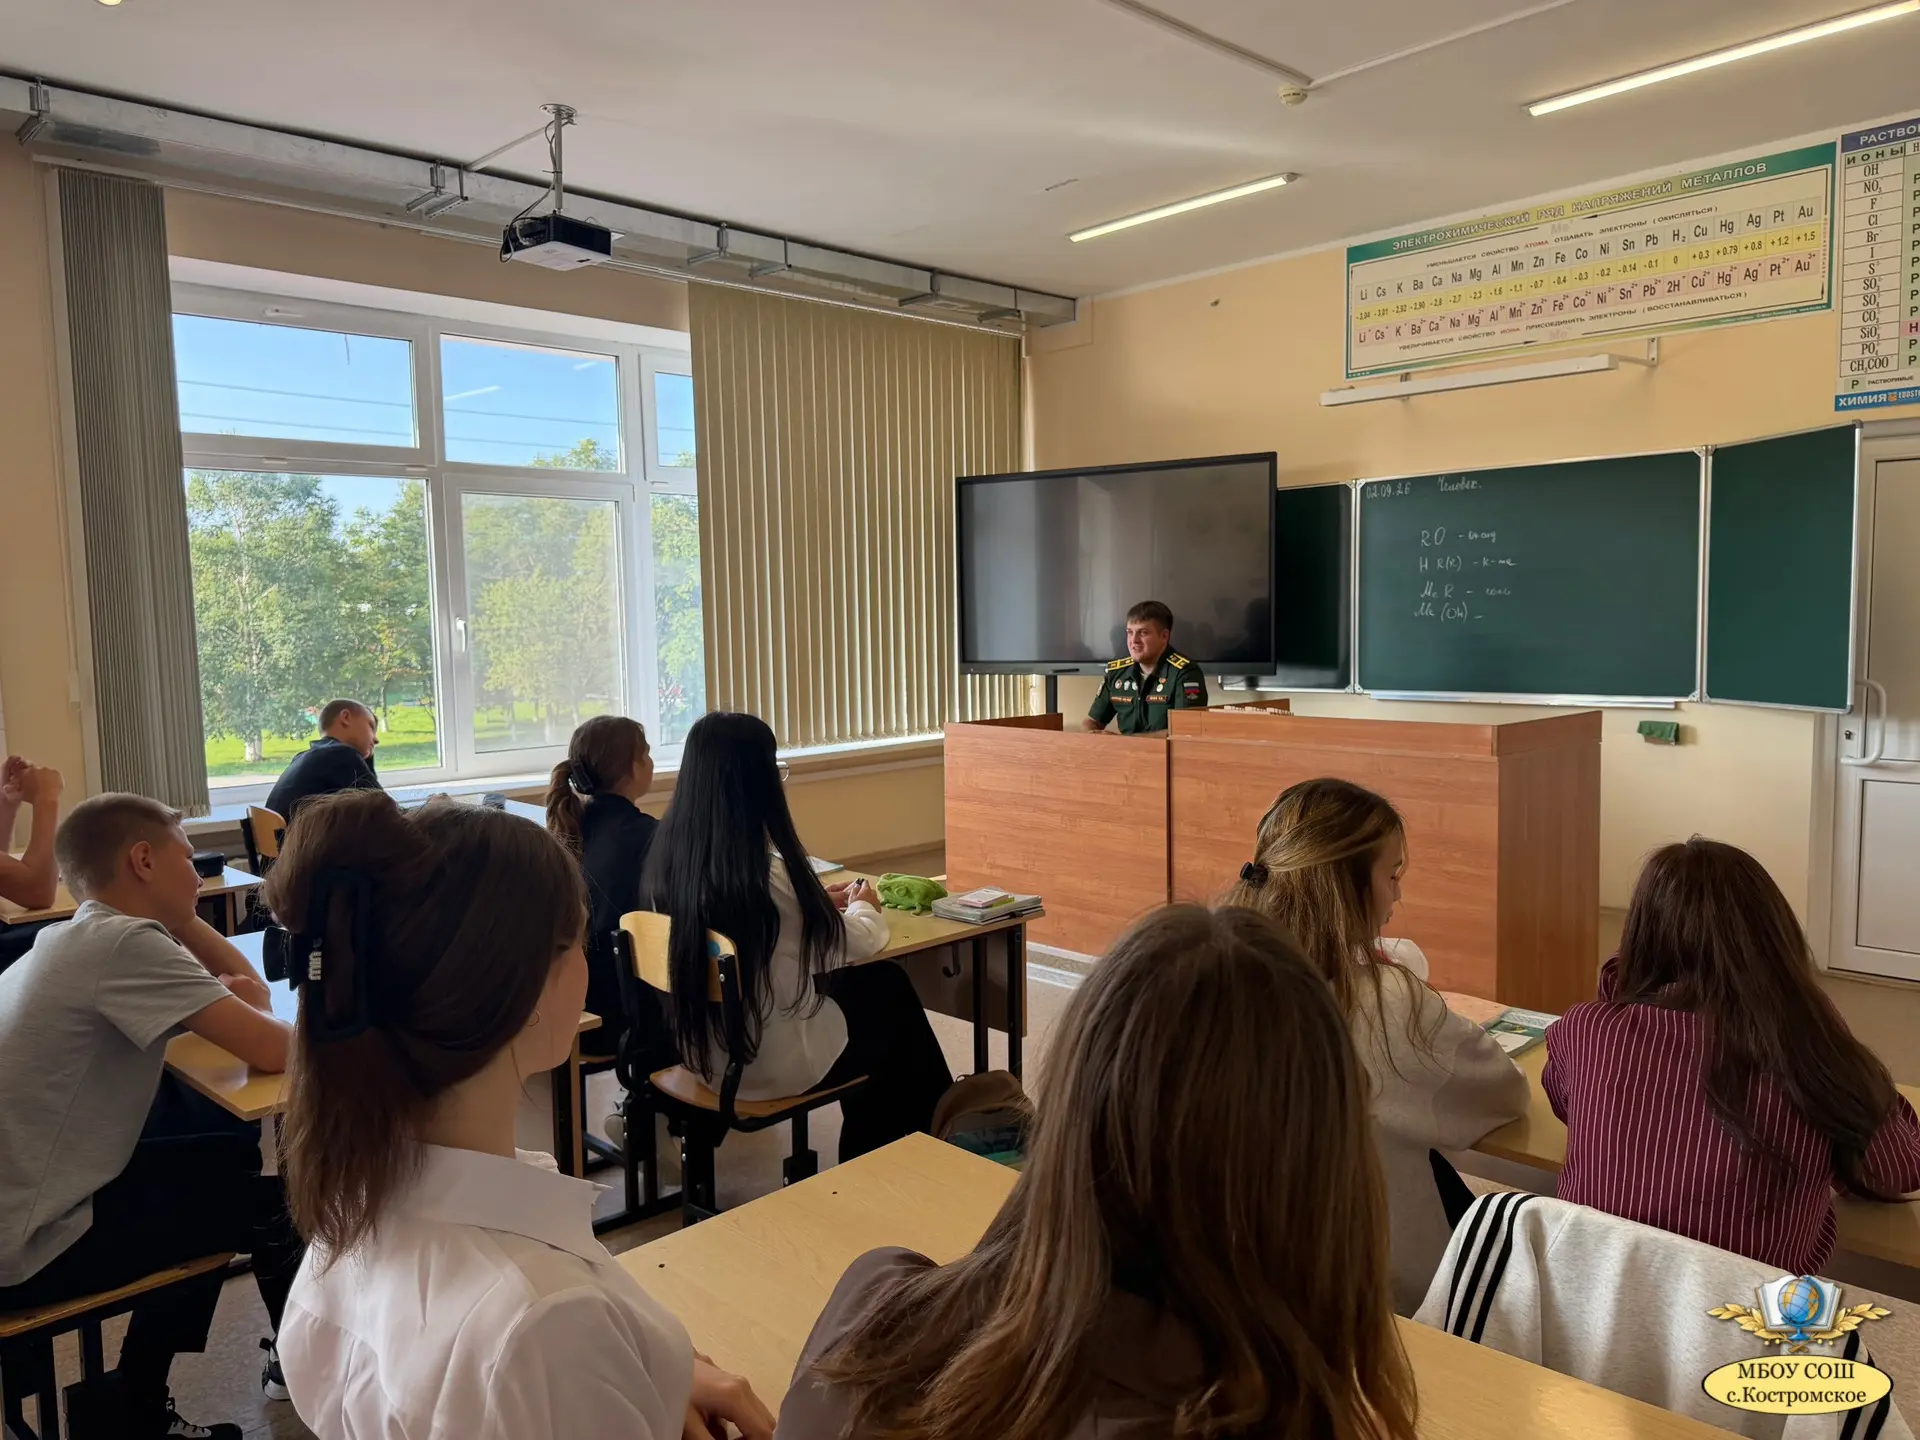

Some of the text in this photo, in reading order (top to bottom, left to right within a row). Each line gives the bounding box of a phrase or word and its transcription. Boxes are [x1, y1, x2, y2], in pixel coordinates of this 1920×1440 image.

[1860, 124, 1920, 145] РАСТВО
[1392, 162, 1767, 250] ЭЛЕКТРОХИМИЧЕСКИЙ РЯД НАПРЯЖЕНИЙ МЕТАЛЛОВ
[1360, 290, 1367, 300] Li
[1376, 286, 1386, 298] Cs
[1397, 282, 1403, 294] K
[1413, 280, 1423, 291] Ba
[1432, 276, 1443, 287] Ca
[1451, 272, 1462, 283] Na
[1470, 268, 1482, 281] Mg
[1492, 264, 1501, 276] Al
[1511, 260, 1524, 272] Mn
[1533, 256, 1544, 268] Zn
[1555, 252, 1566, 264] Fe
[1575, 248, 1588, 260] Co
[1600, 242, 1610, 255] Ni
[1622, 239, 1635, 251] Sn
[1645, 234, 1659, 247] Pb
[1694, 225, 1707, 238] Cu
[1720, 219, 1734, 234] Hg
[1746, 214, 1761, 228] Ag
[1773, 209, 1784, 223] Pt
[1798, 205, 1813, 218] Au
[1426, 254, 1476, 268] УМЕНЬШАЕТСЯ
[1481, 245, 1519, 257] СВОЙСТВО
[1524, 240, 1549, 249] АТОМА
[1554, 232, 1594, 243] ОТДАВАТЬ
[1600, 220, 1647, 234] ЭЛЕКТРОНЫ
[1525, 317, 1585, 331] ПРИСОЕДИНЯТЬ
[1589, 309, 1637, 321] ЭЛЕКТРОНЫ
[1851, 375, 1914, 390] Р РАСТВОРИМЫЕ
[1838, 393, 1887, 407] ХИМИЯ
